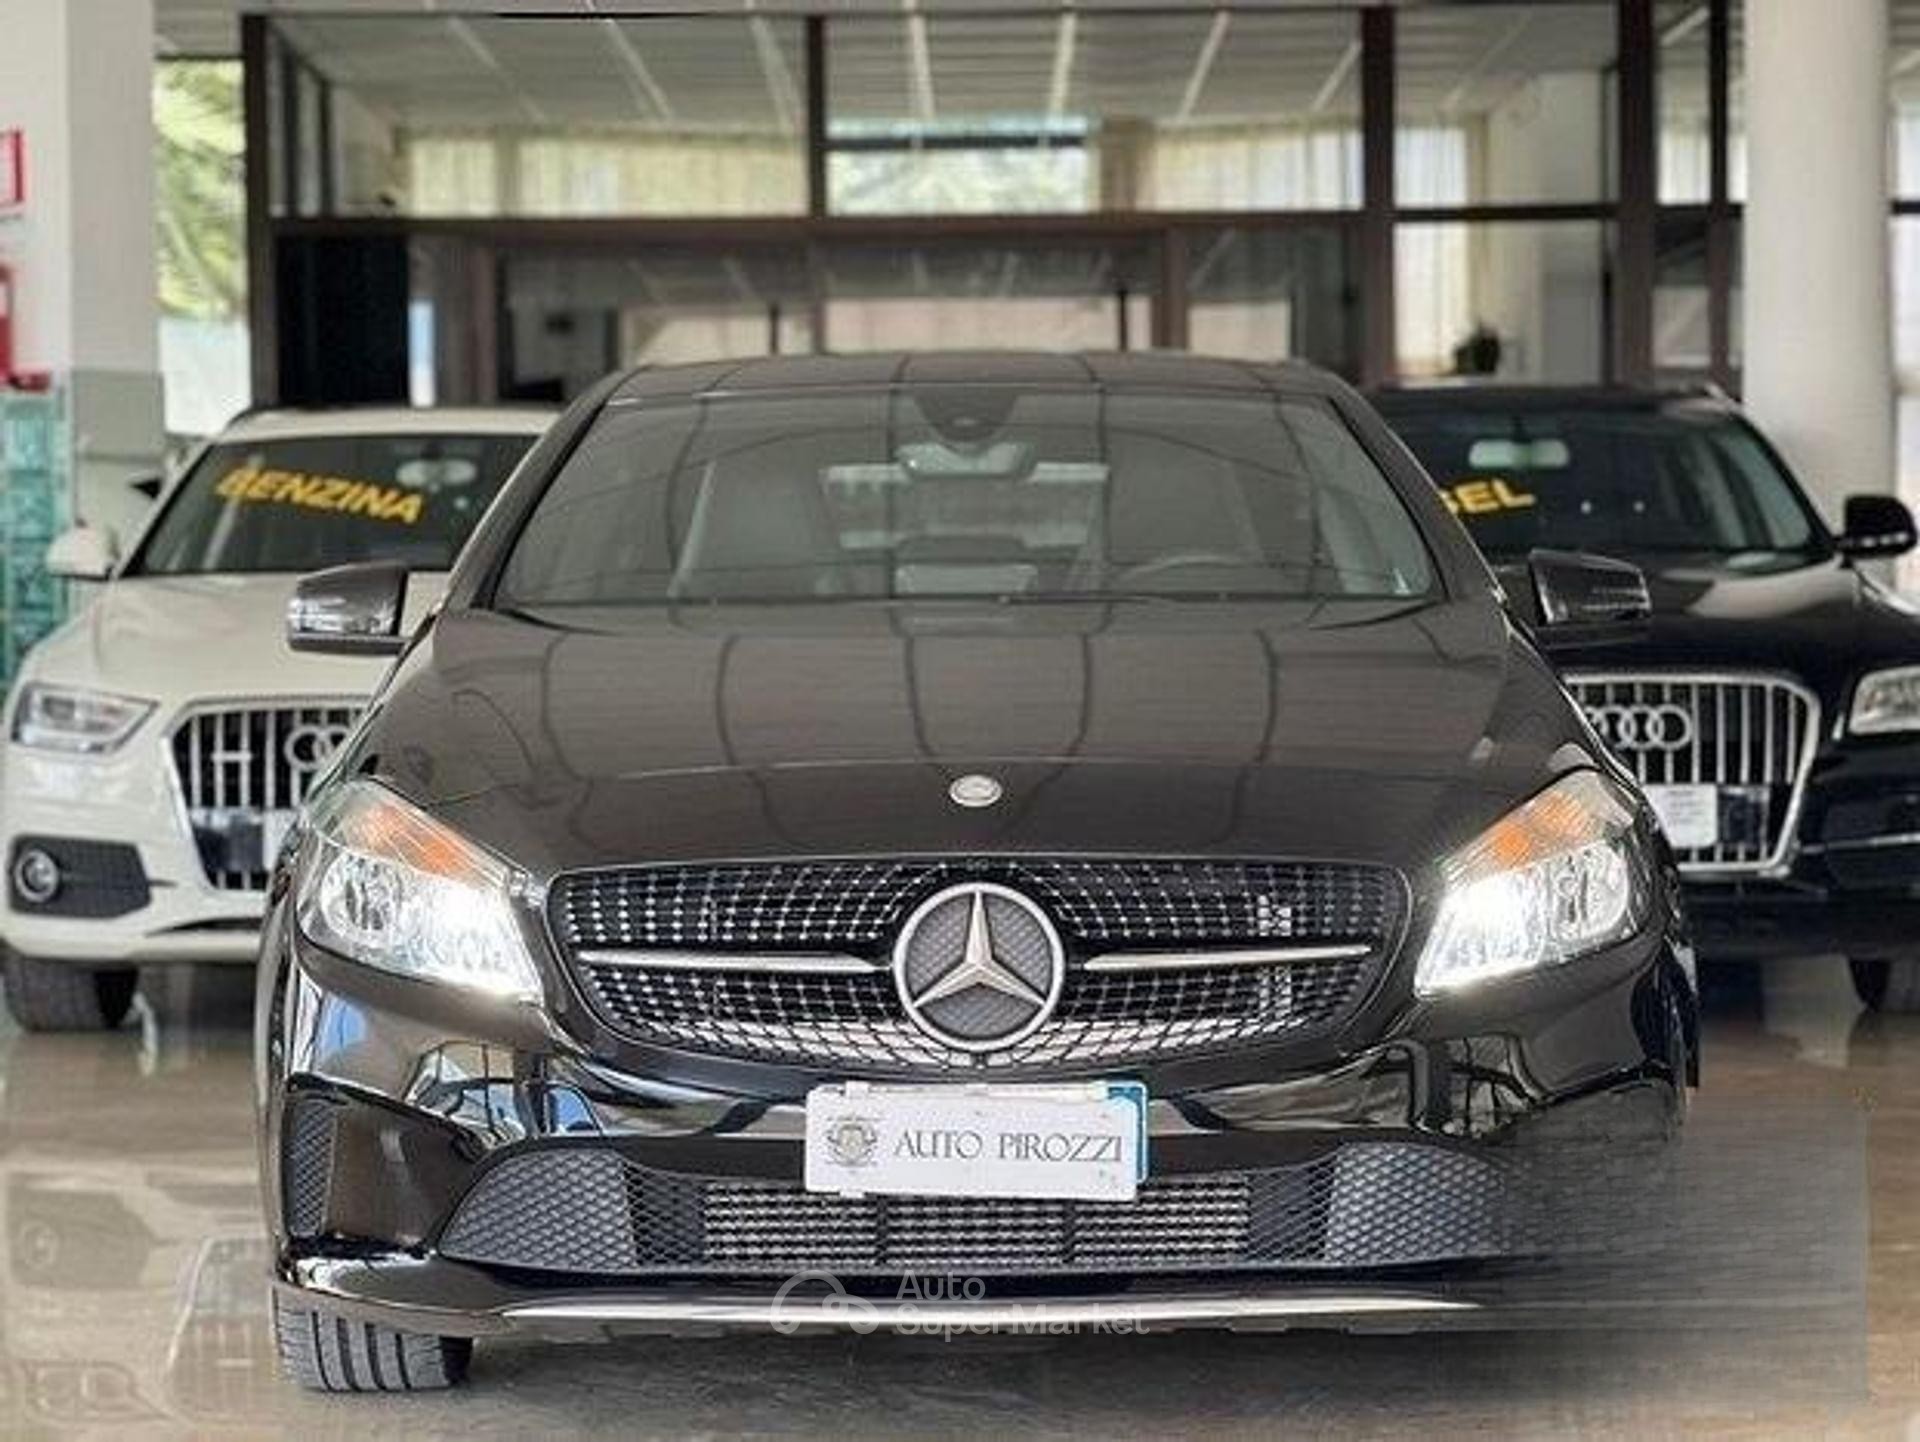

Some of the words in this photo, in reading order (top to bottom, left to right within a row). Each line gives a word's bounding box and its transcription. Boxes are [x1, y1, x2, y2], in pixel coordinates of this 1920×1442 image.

[215, 467, 424, 524] BENZINA
[895, 1130, 983, 1160] AUTO
[998, 1132, 1123, 1163] PIROZZI
